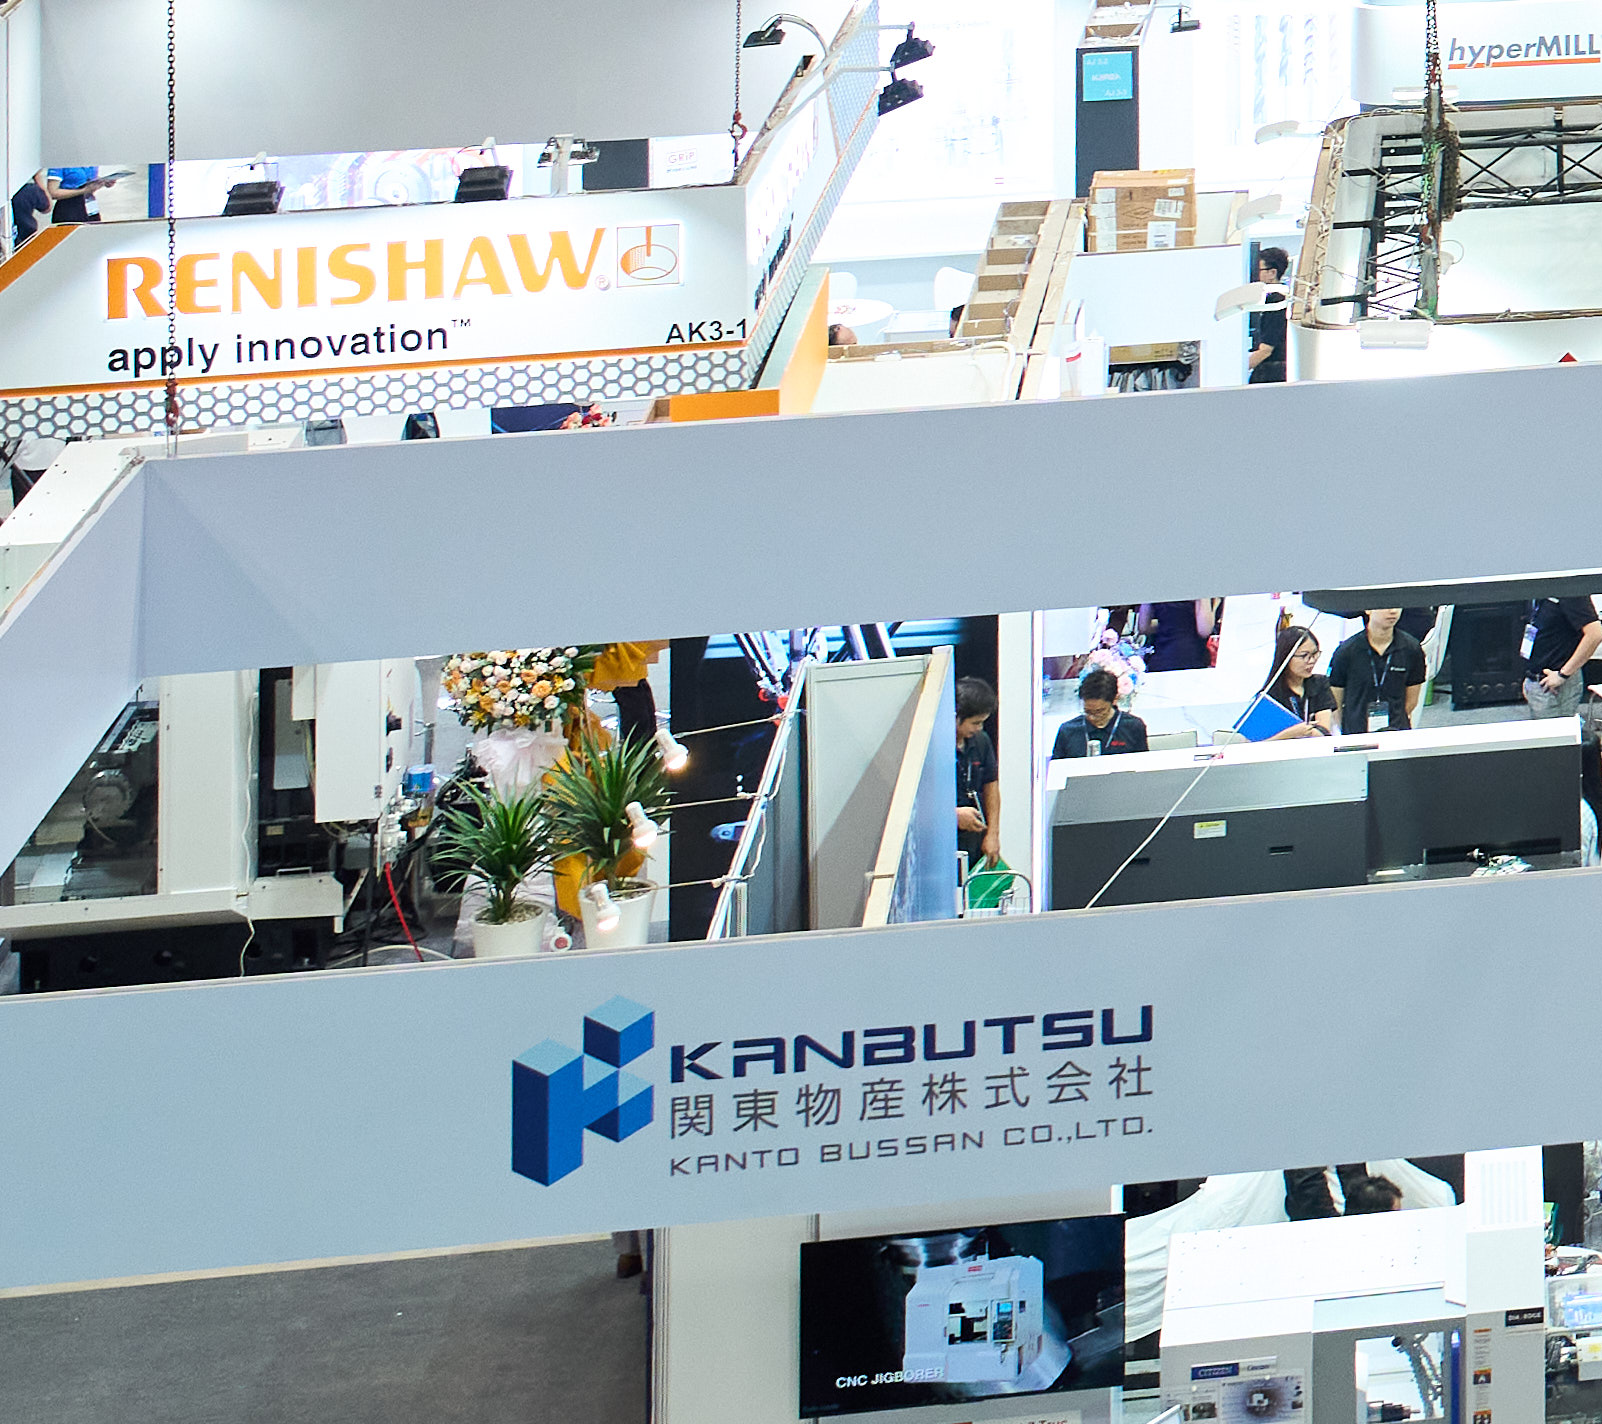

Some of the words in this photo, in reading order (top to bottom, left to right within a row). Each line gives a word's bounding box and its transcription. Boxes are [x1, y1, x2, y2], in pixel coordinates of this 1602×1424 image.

[1448, 33, 1602, 68] hyperMILL
[105, 226, 608, 322] RENISHAW
[107, 336, 221, 379] apply
[234, 324, 450, 366] innovation
[665, 318, 747, 345] AK3-1
[670, 1003, 1154, 1085] KANBUTSU
[669, 1053, 1155, 1141] 関東物産株式会社
[669, 1145, 801, 1178] KANTO
[819, 1129, 984, 1165] BUSSAN
[1002, 1115, 1155, 1148] CO.,LTD.
[835, 1373, 868, 1389] CNC
